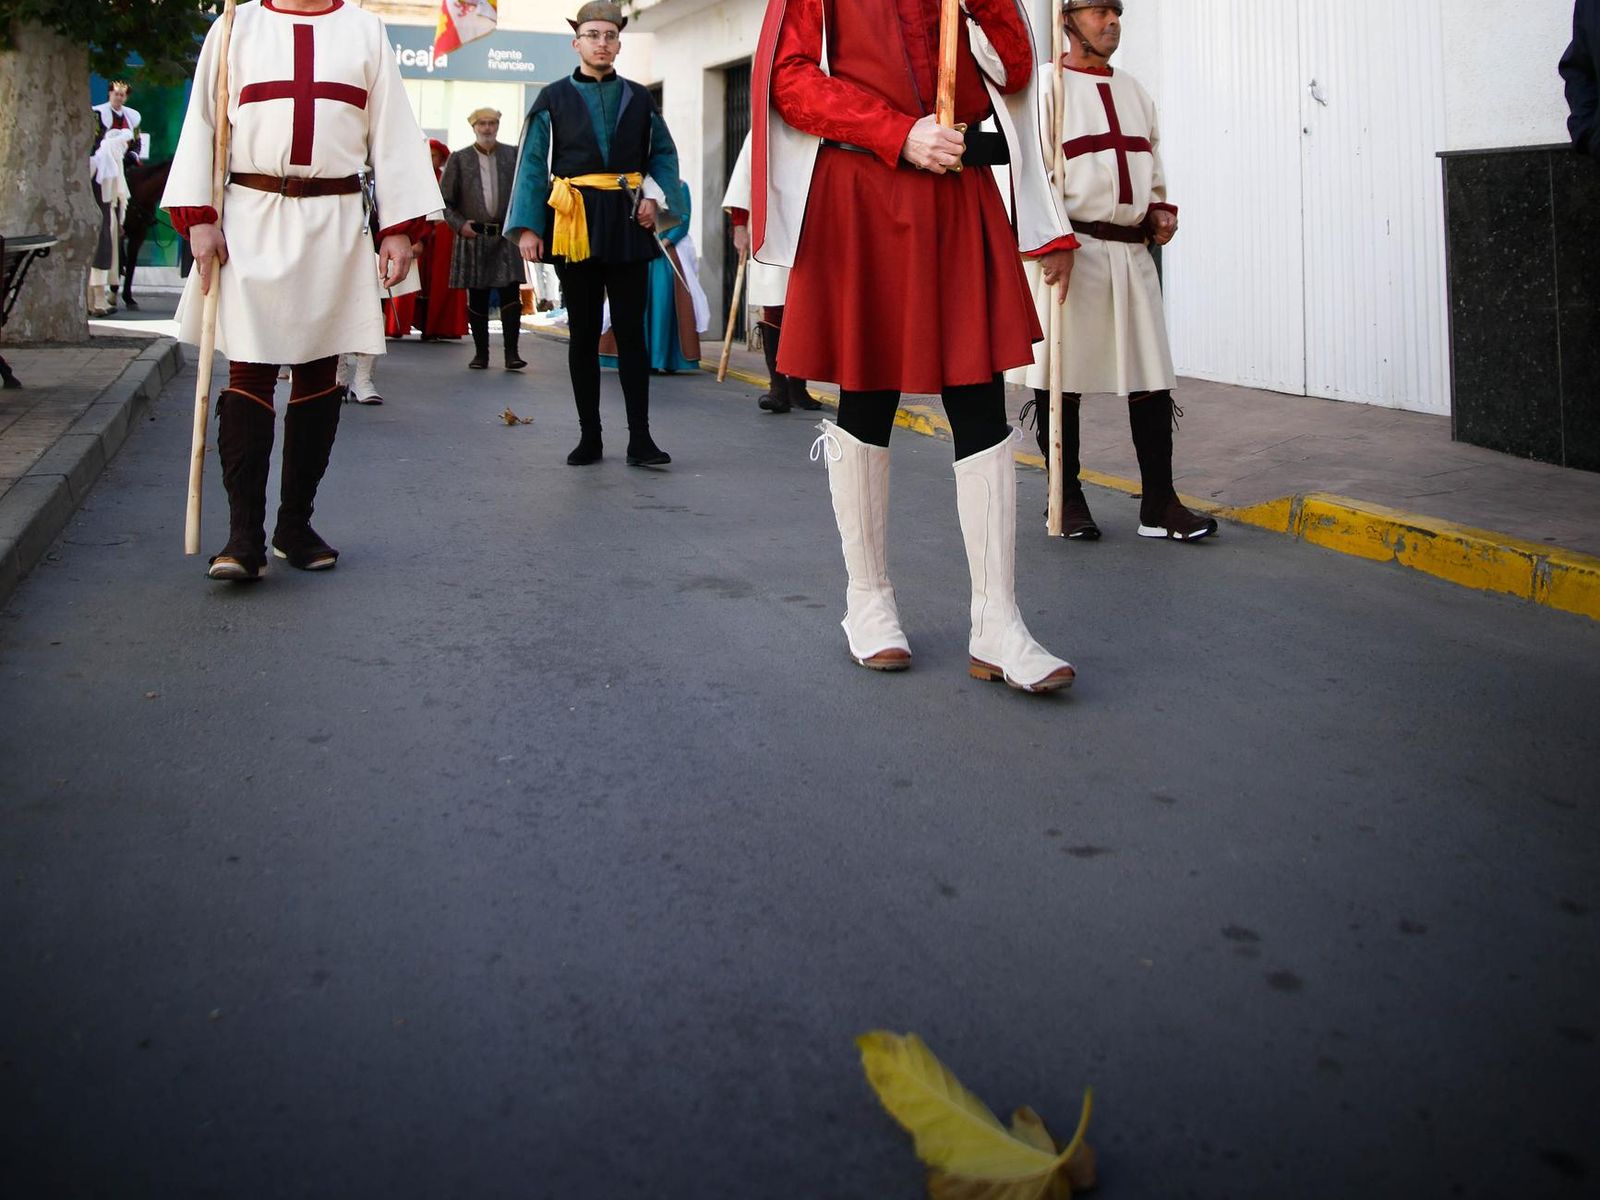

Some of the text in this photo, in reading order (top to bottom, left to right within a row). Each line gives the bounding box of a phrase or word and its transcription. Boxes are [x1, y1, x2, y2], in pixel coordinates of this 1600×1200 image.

[396, 43, 448, 73] icaja
[488, 48, 522, 60] Agente
[488, 59, 535, 71] financiero
